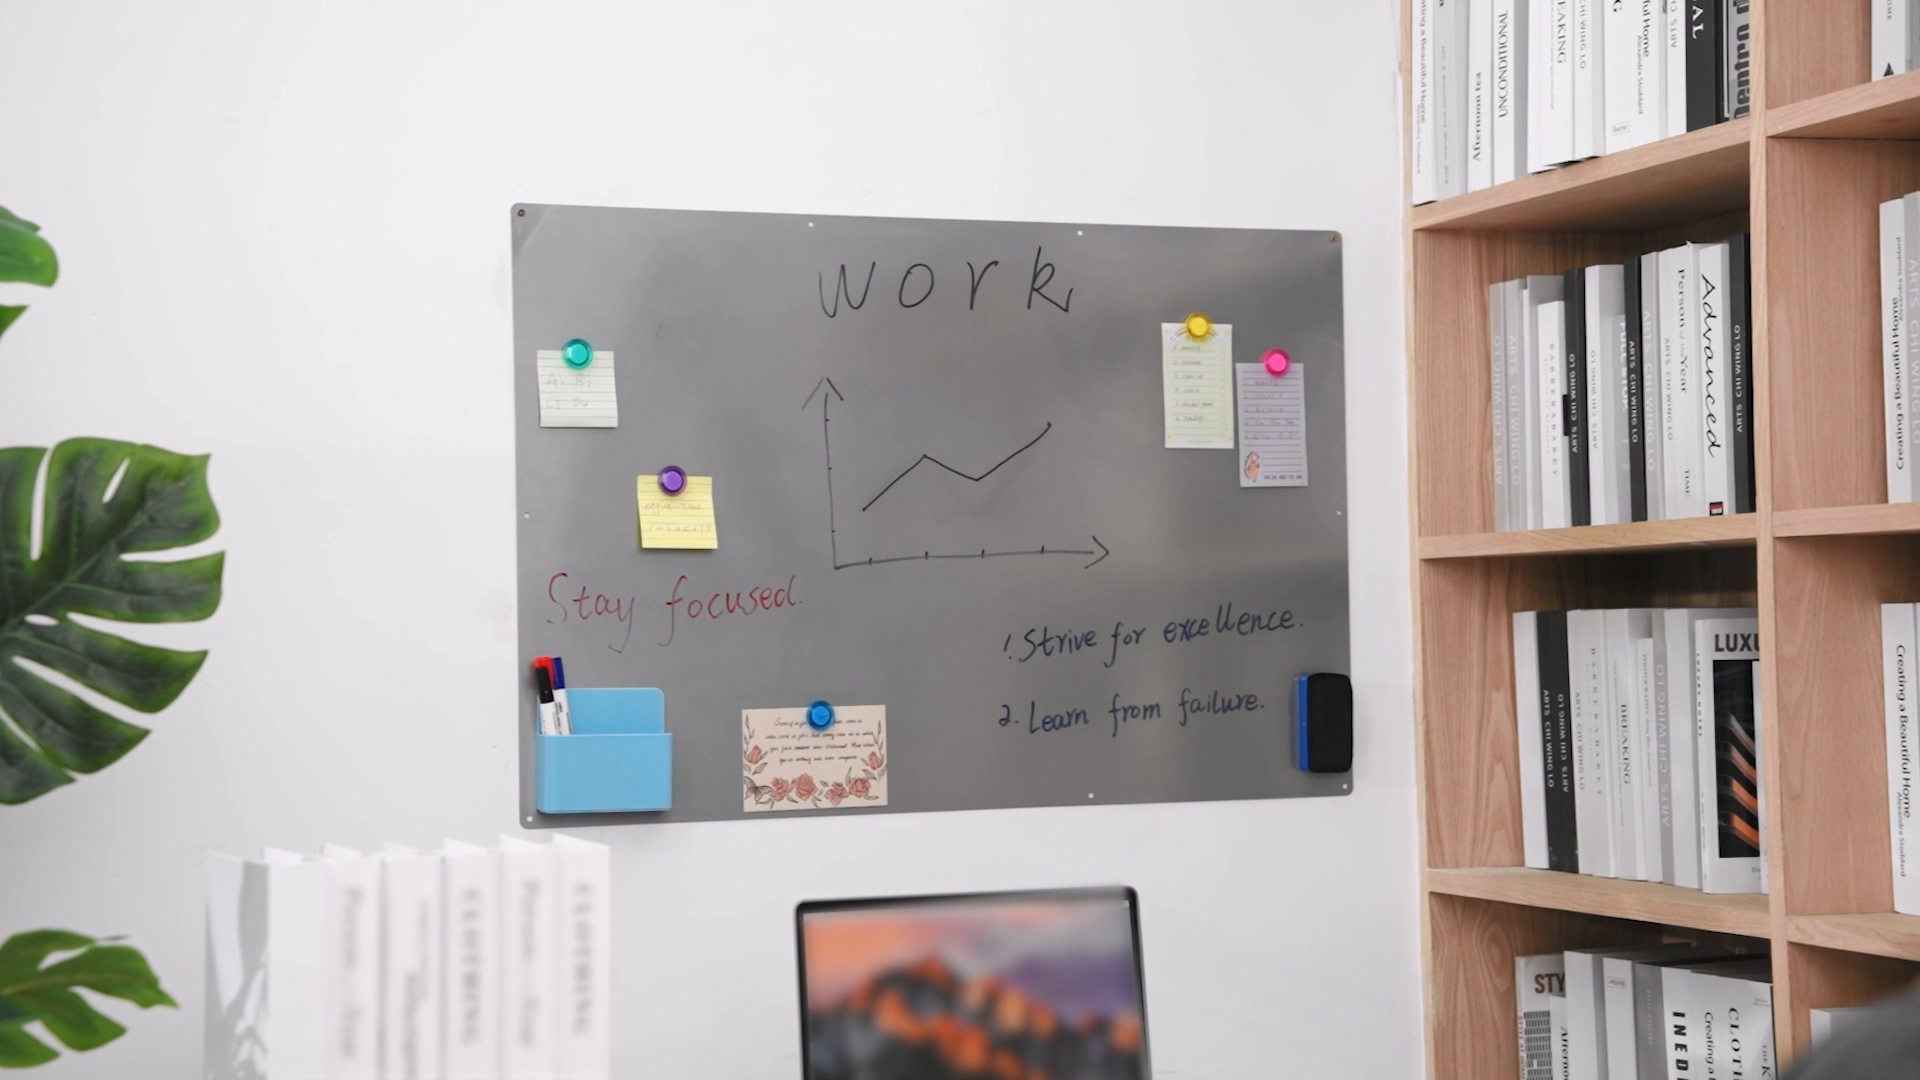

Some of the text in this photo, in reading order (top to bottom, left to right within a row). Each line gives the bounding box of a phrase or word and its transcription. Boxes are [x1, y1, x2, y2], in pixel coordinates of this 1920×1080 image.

[1579, 20, 1588, 51] WING
[1642, 18, 1651, 58] Home
[1670, 19, 1678, 48] ARTS
[1497, 9, 1508, 118] UNCONDITIONAL
[1580, 54, 1587, 69] LO
[1472, 94, 1481, 162] Afternoon
[1678, 268, 1686, 328] Person
[1891, 297, 1900, 338] Home
[1568, 354, 1576, 368] LO
[1589, 350, 1595, 364] LO
[1701, 273, 1721, 459] Advanced
[1892, 341, 1902, 400] Beautiful
[1908, 259, 1920, 444] ARTS CHI WING LO
[1569, 371, 1577, 401] WING
[1642, 310, 1656, 471] ARTS CHI WING LO
[1680, 355, 1689, 395] Year
[1733, 325, 1743, 433] ARTS CHI WING LO
[1570, 402, 1578, 421] CHI
[1632, 429, 1639, 443] LO
[1667, 426, 1673, 441] LO
[1895, 413, 1904, 471] Creating
[546, 572, 636, 653] Stay
[1018, 626, 1098, 662] Strive
[1103, 622, 1147, 668] for
[1896, 645, 1906, 702] Creating
[1029, 701, 1090, 734] Learn
[1108, 693, 1161, 737] from
[1543, 689, 1551, 716] ARTS
[1557, 693, 1564, 709] LO
[1546, 743, 1554, 772] WING
[1620, 704, 1630, 784] BREAKING
[1656, 664, 1671, 827] ARTS CHI WING LO
[1899, 714, 1911, 774] Beautiful
[1547, 774, 1555, 788] LO
[1561, 766, 1569, 794] ARTS
[1579, 777, 1586, 791] LO
[1901, 778, 1911, 818] Home
[1704, 1012, 1716, 1065] Creating
